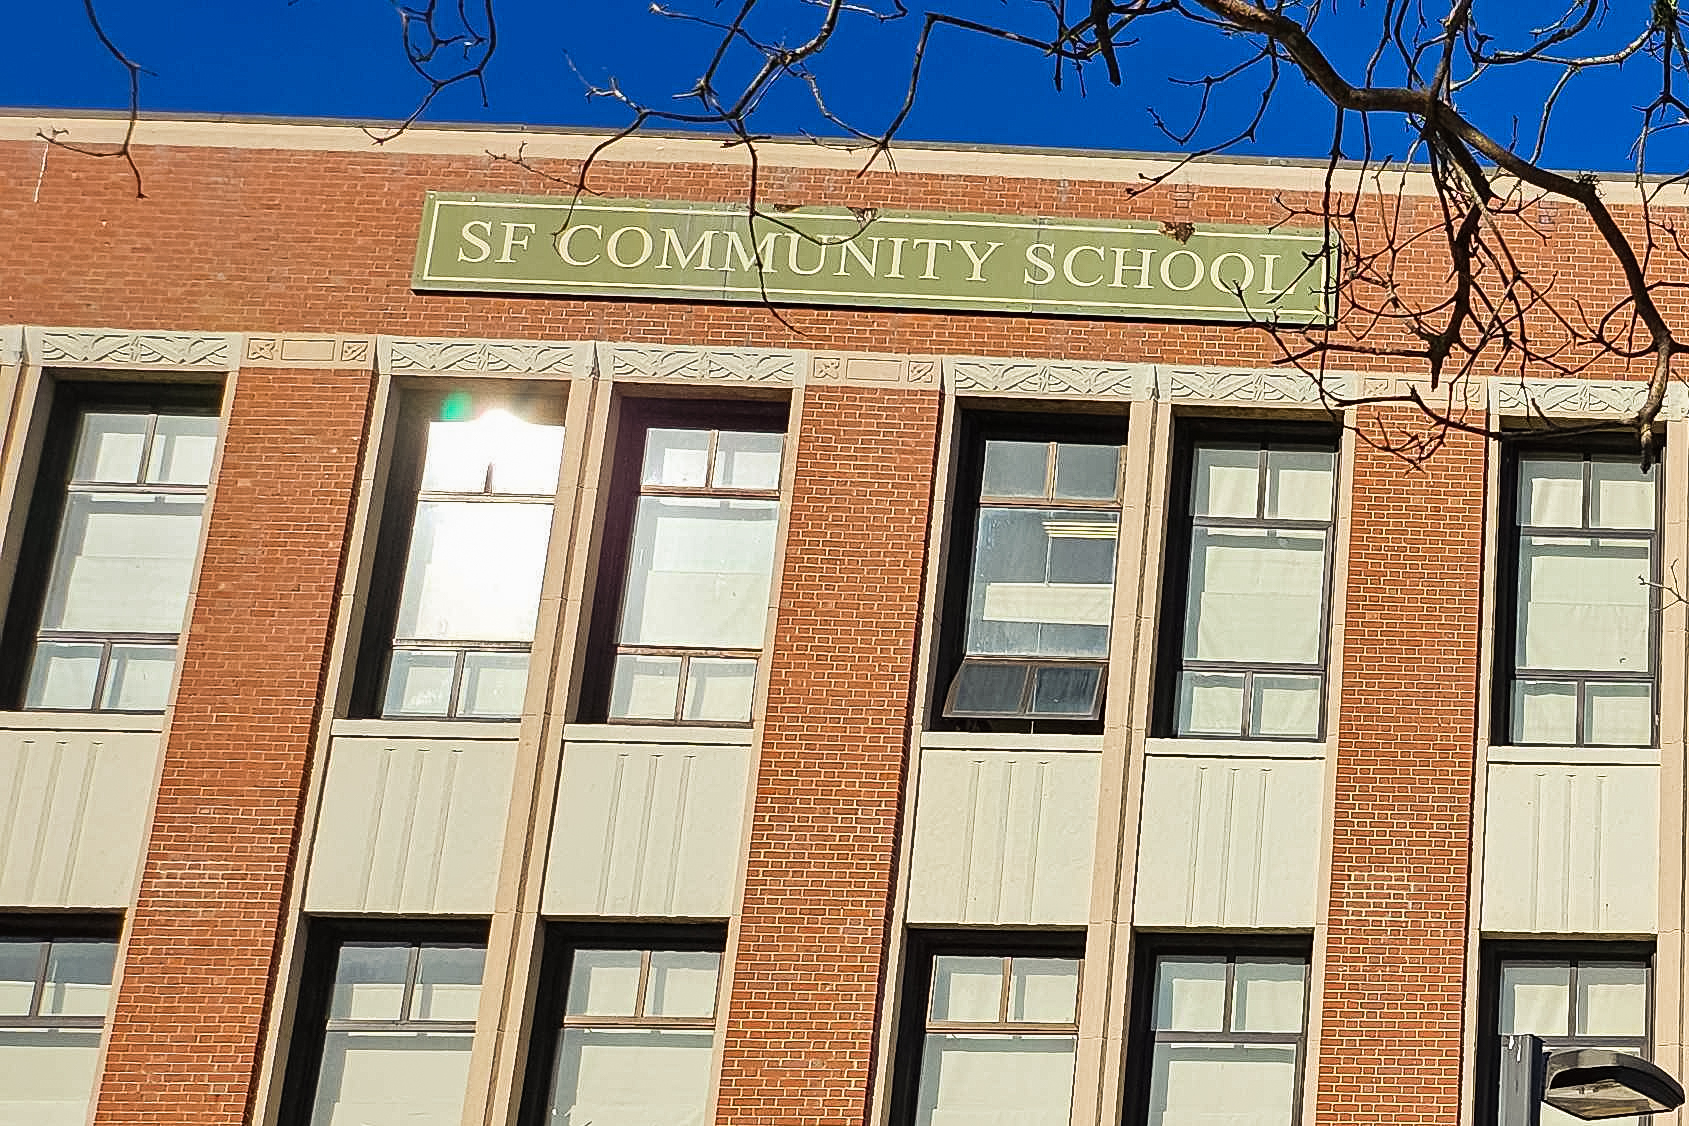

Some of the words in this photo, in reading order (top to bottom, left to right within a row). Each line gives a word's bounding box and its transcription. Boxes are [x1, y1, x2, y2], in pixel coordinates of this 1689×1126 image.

[457, 220, 536, 264] SF
[558, 224, 1003, 283] COMMUNITY
[1023, 243, 1297, 296] SCHOOL
